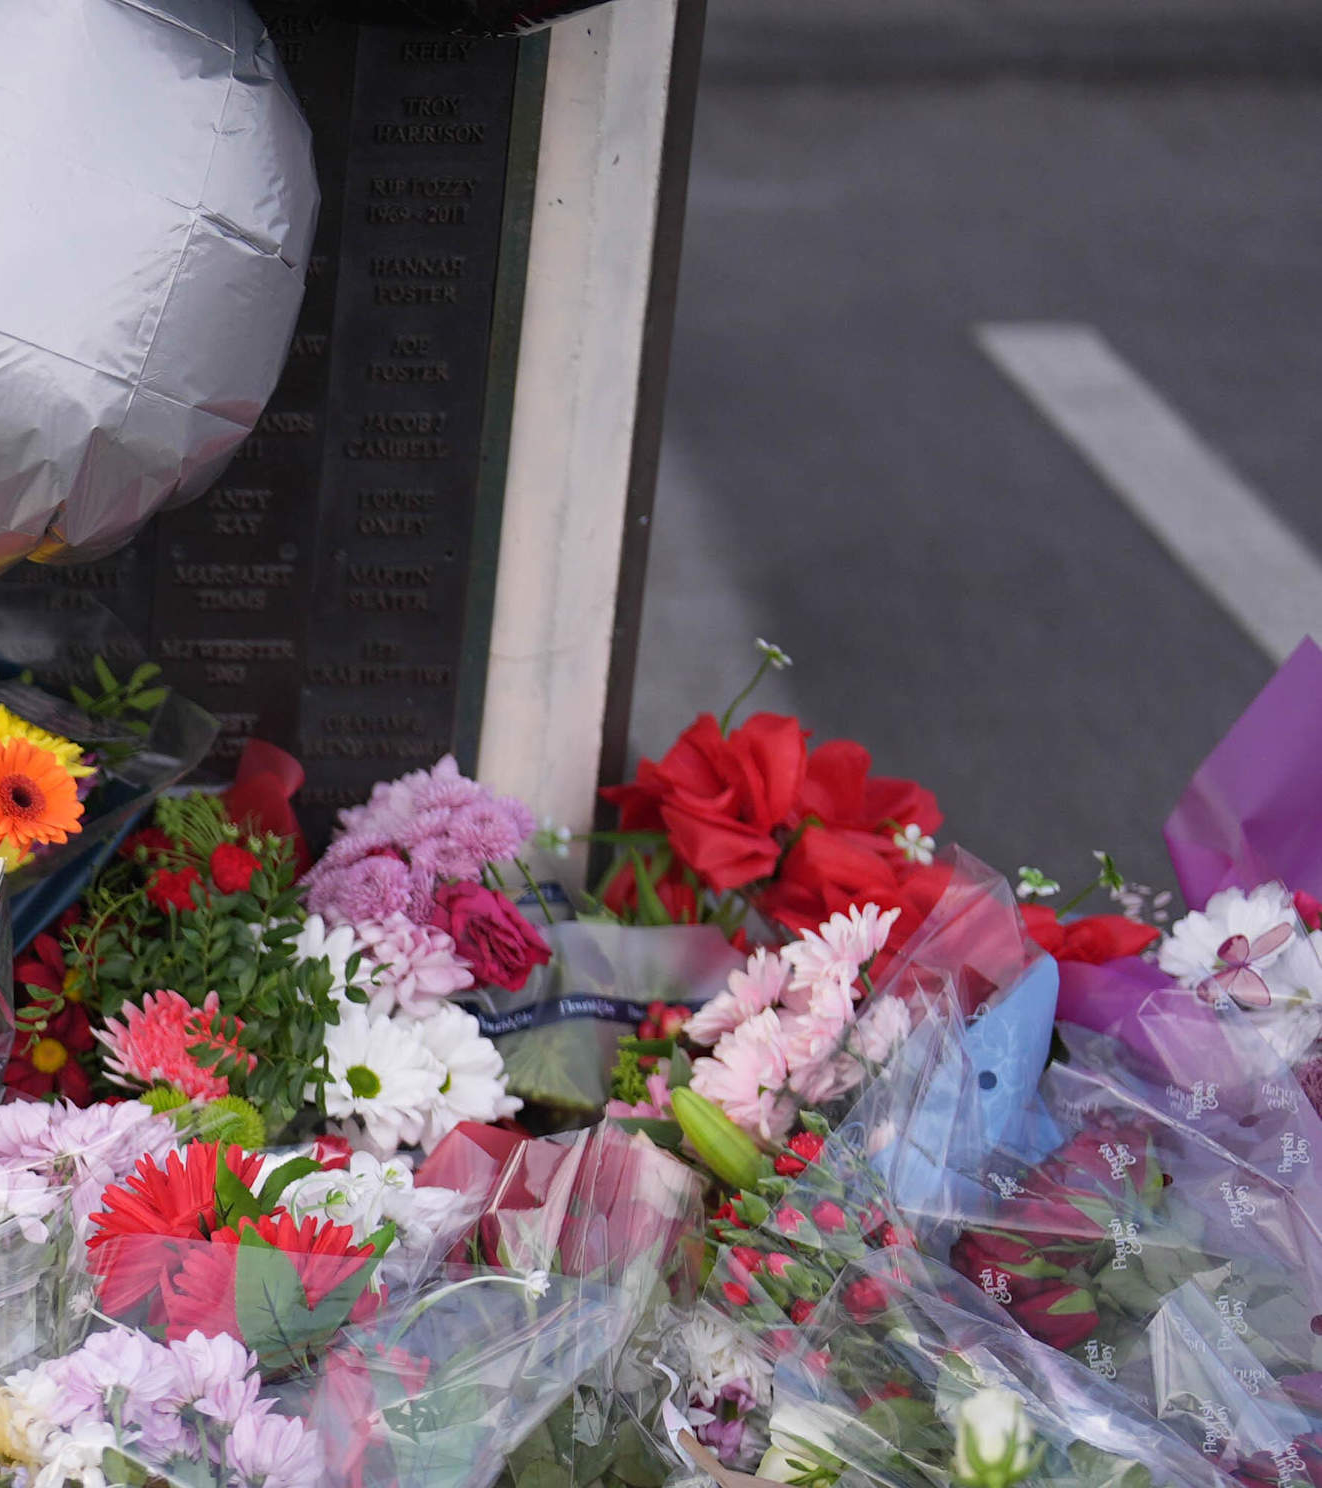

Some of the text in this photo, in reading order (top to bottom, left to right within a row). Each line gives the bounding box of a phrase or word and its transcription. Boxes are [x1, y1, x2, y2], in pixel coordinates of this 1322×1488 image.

[404, 42, 470, 63] KELLY
[404, 98, 461, 118] TROY
[375, 124, 485, 145] HARRISON
[370, 257, 468, 278] HANNAH
[375, 284, 459, 305] FOSTER
[1108, 1217, 1128, 1271] Flourish
